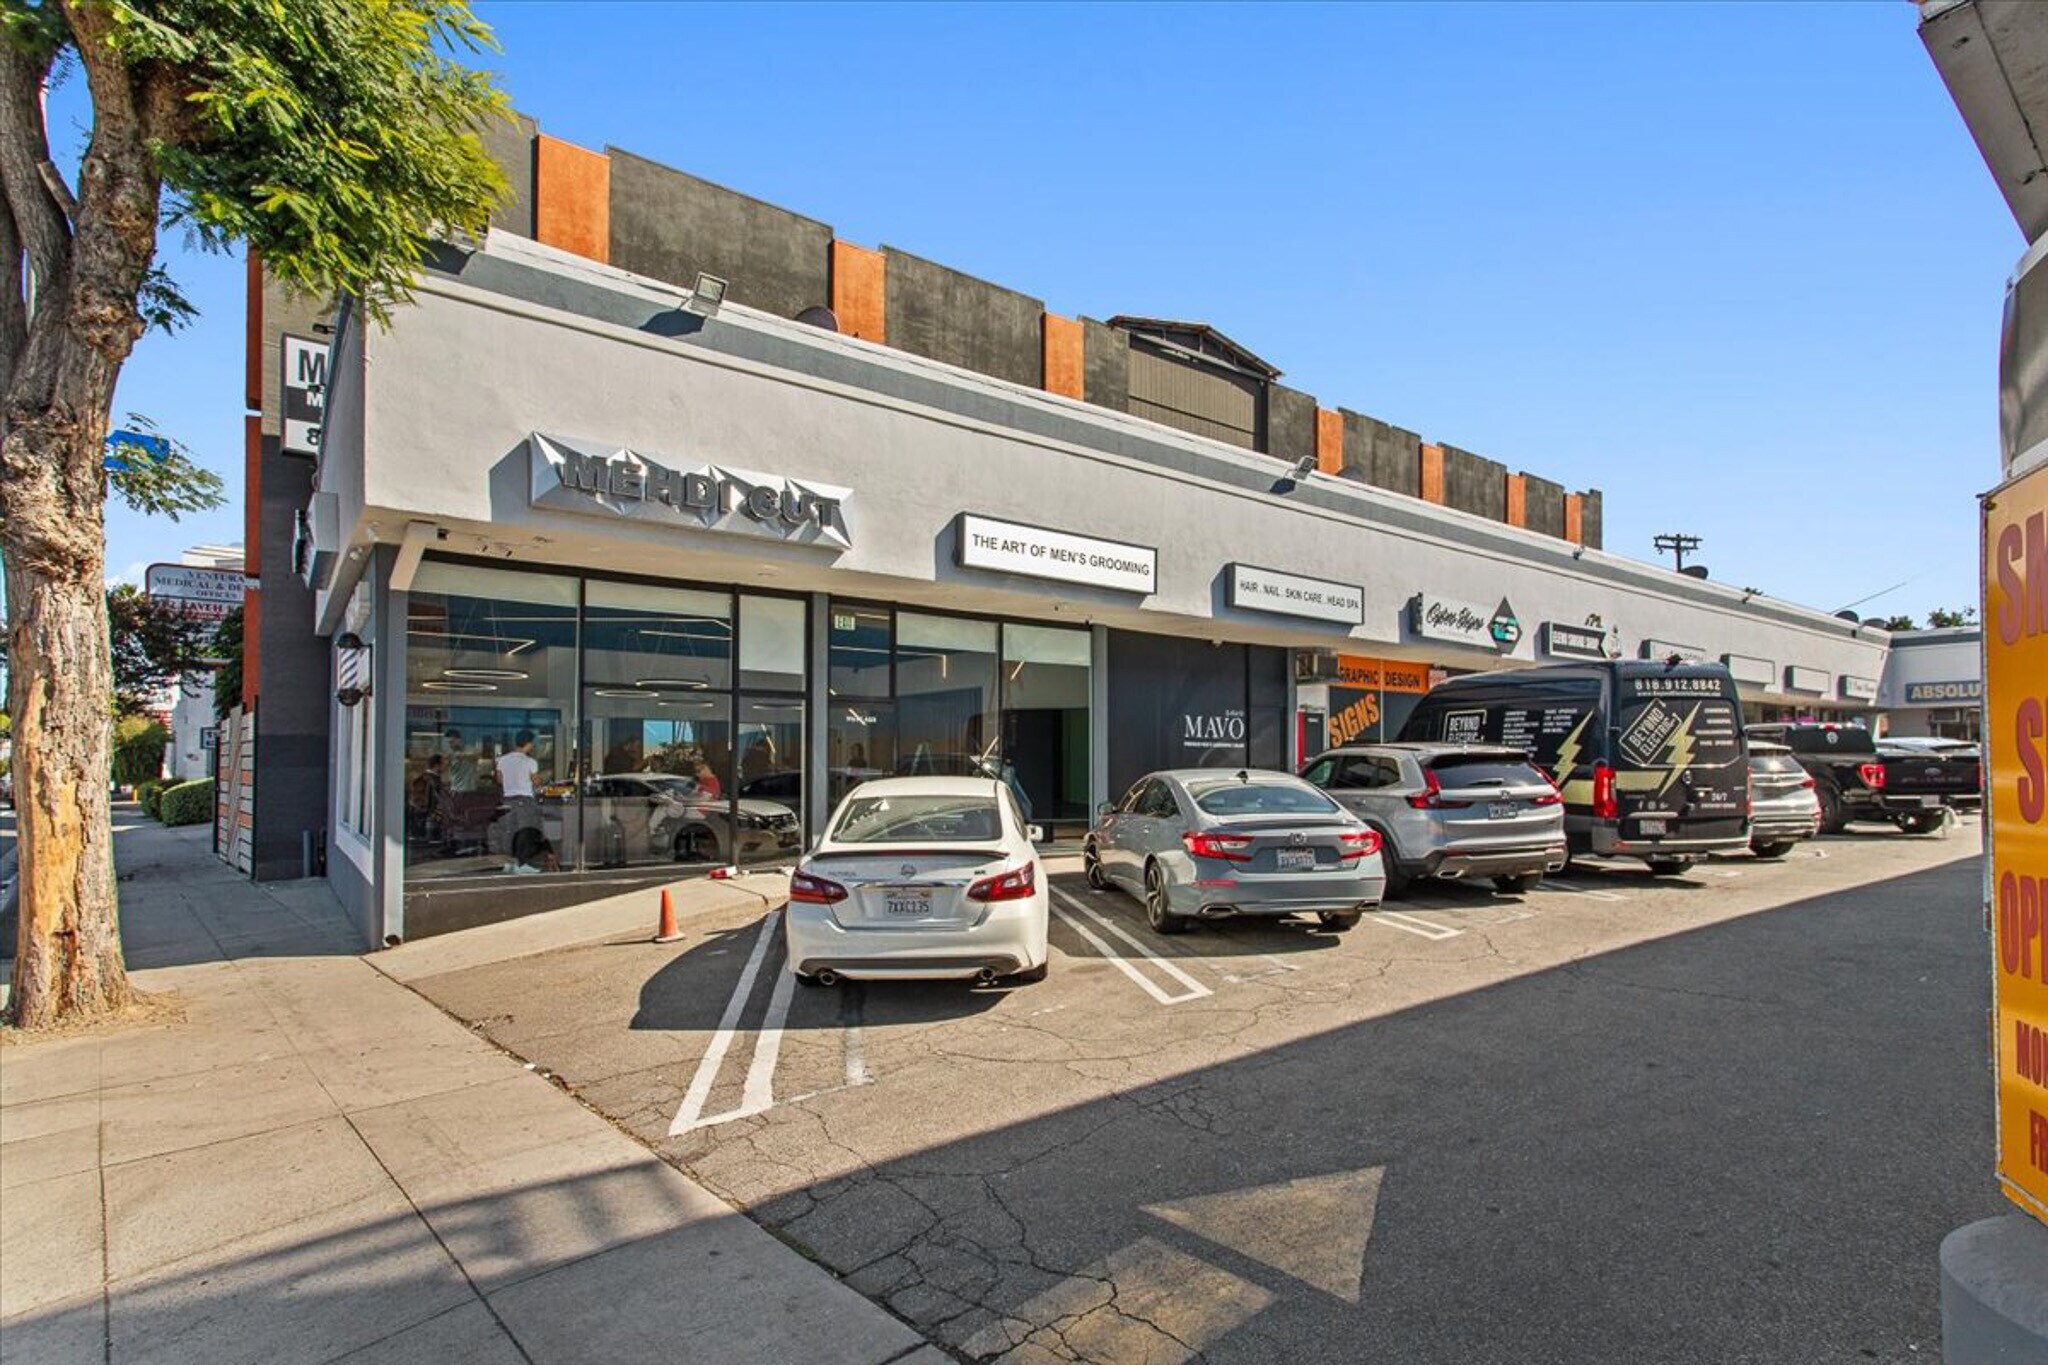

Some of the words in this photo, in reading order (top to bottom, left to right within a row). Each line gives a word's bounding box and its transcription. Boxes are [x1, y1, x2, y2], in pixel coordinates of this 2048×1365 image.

[563, 452, 731, 514] MEHDI
[748, 485, 841, 528] CUT
[972, 533, 998, 550] THE
[1001, 540, 1027, 555] ART
[1030, 544, 1047, 559] OF
[1050, 548, 1087, 566] MEN'S
[1089, 555, 1150, 576] GROOMING
[155, 576, 213, 590] MEDICAL
[185, 570, 244, 582] VENTURA
[1240, 581, 1258, 592] HAIR
[1263, 585, 1280, 597] NAIL
[1285, 588, 1302, 600] SKIN
[1303, 591, 1322, 603] CARE
[1327, 596, 1345, 608] HEAD
[1346, 598, 1359, 609] SPA
[1339, 667, 1379, 685] GRAPHIC
[1384, 671, 1420, 687] DESIGN
[1184, 714, 1245, 740] MAVO
[1328, 693, 1380, 749] SIGNS
[1449, 716, 1480, 731] BEYOND
[1628, 707, 1665, 748] BEYOND
[1639, 717, 1676, 757] ELECTRIC
[2016, 696, 2048, 824] S
